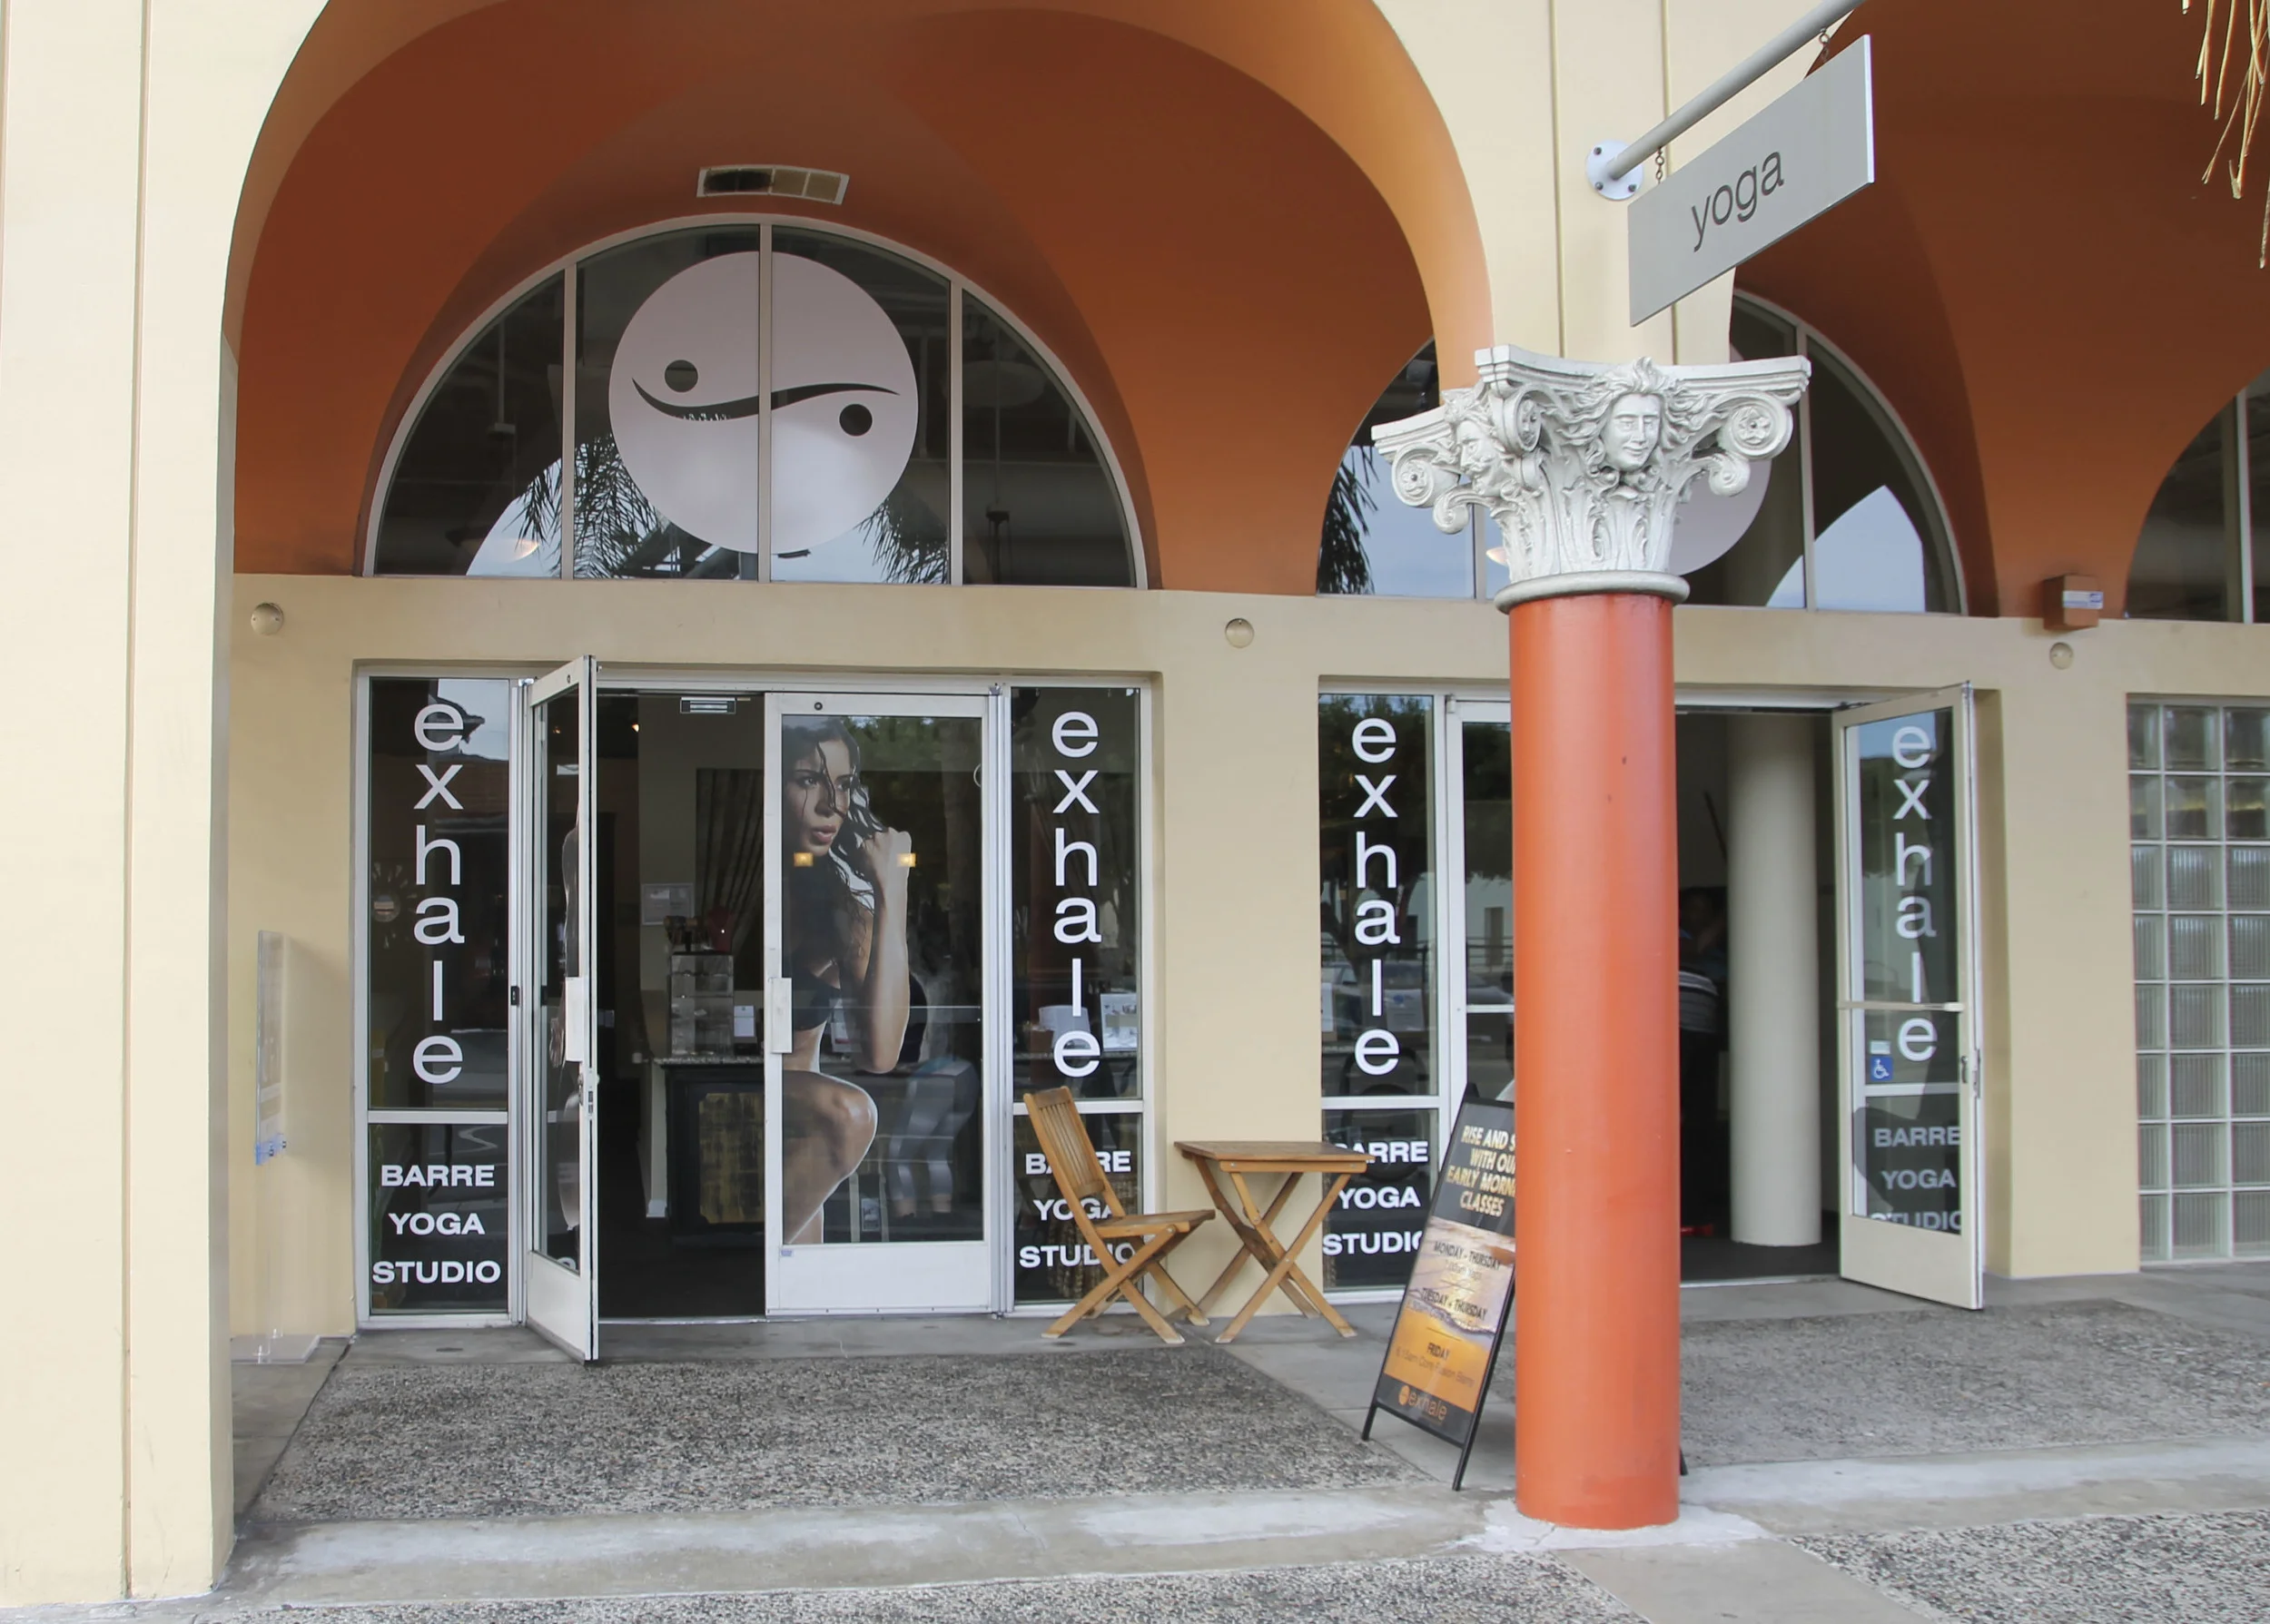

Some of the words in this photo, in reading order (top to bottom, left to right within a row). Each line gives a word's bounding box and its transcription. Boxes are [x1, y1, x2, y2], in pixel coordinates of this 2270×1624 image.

[1691, 151, 1784, 252] yoga
[412, 703, 466, 1084] exhale
[1051, 710, 1102, 1078] exhale
[1350, 717, 1399, 1075] exhale
[1891, 724, 1938, 1063] exhale
[1463, 1125, 1484, 1146] RISE
[1483, 1129, 1508, 1149] AND
[1873, 1127, 1961, 1147] BARRE
[1025, 1150, 1132, 1175] BRE
[1335, 1141, 1428, 1164] RRE
[1470, 1147, 1496, 1170] WITH
[381, 1165, 495, 1186] BARRE
[1446, 1166, 1481, 1188] EARLY
[1479, 1172, 1516, 1197] MORN
[1880, 1168, 1957, 1190] YOGA
[1338, 1186, 1421, 1209] YOGA
[1460, 1191, 1505, 1217] CLASSES
[388, 1212, 486, 1235] YOGA
[1434, 1241, 1465, 1260] MONDAY
[1469, 1250, 1501, 1271] THURSDAY
[372, 1260, 501, 1284] STUDIO
[1422, 1287, 1449, 1307] TUESDAY
[1455, 1299, 1487, 1321] THURSDAY
[1426, 1342, 1450, 1360] FRIDAY
[1408, 1391, 1447, 1421] exhale
